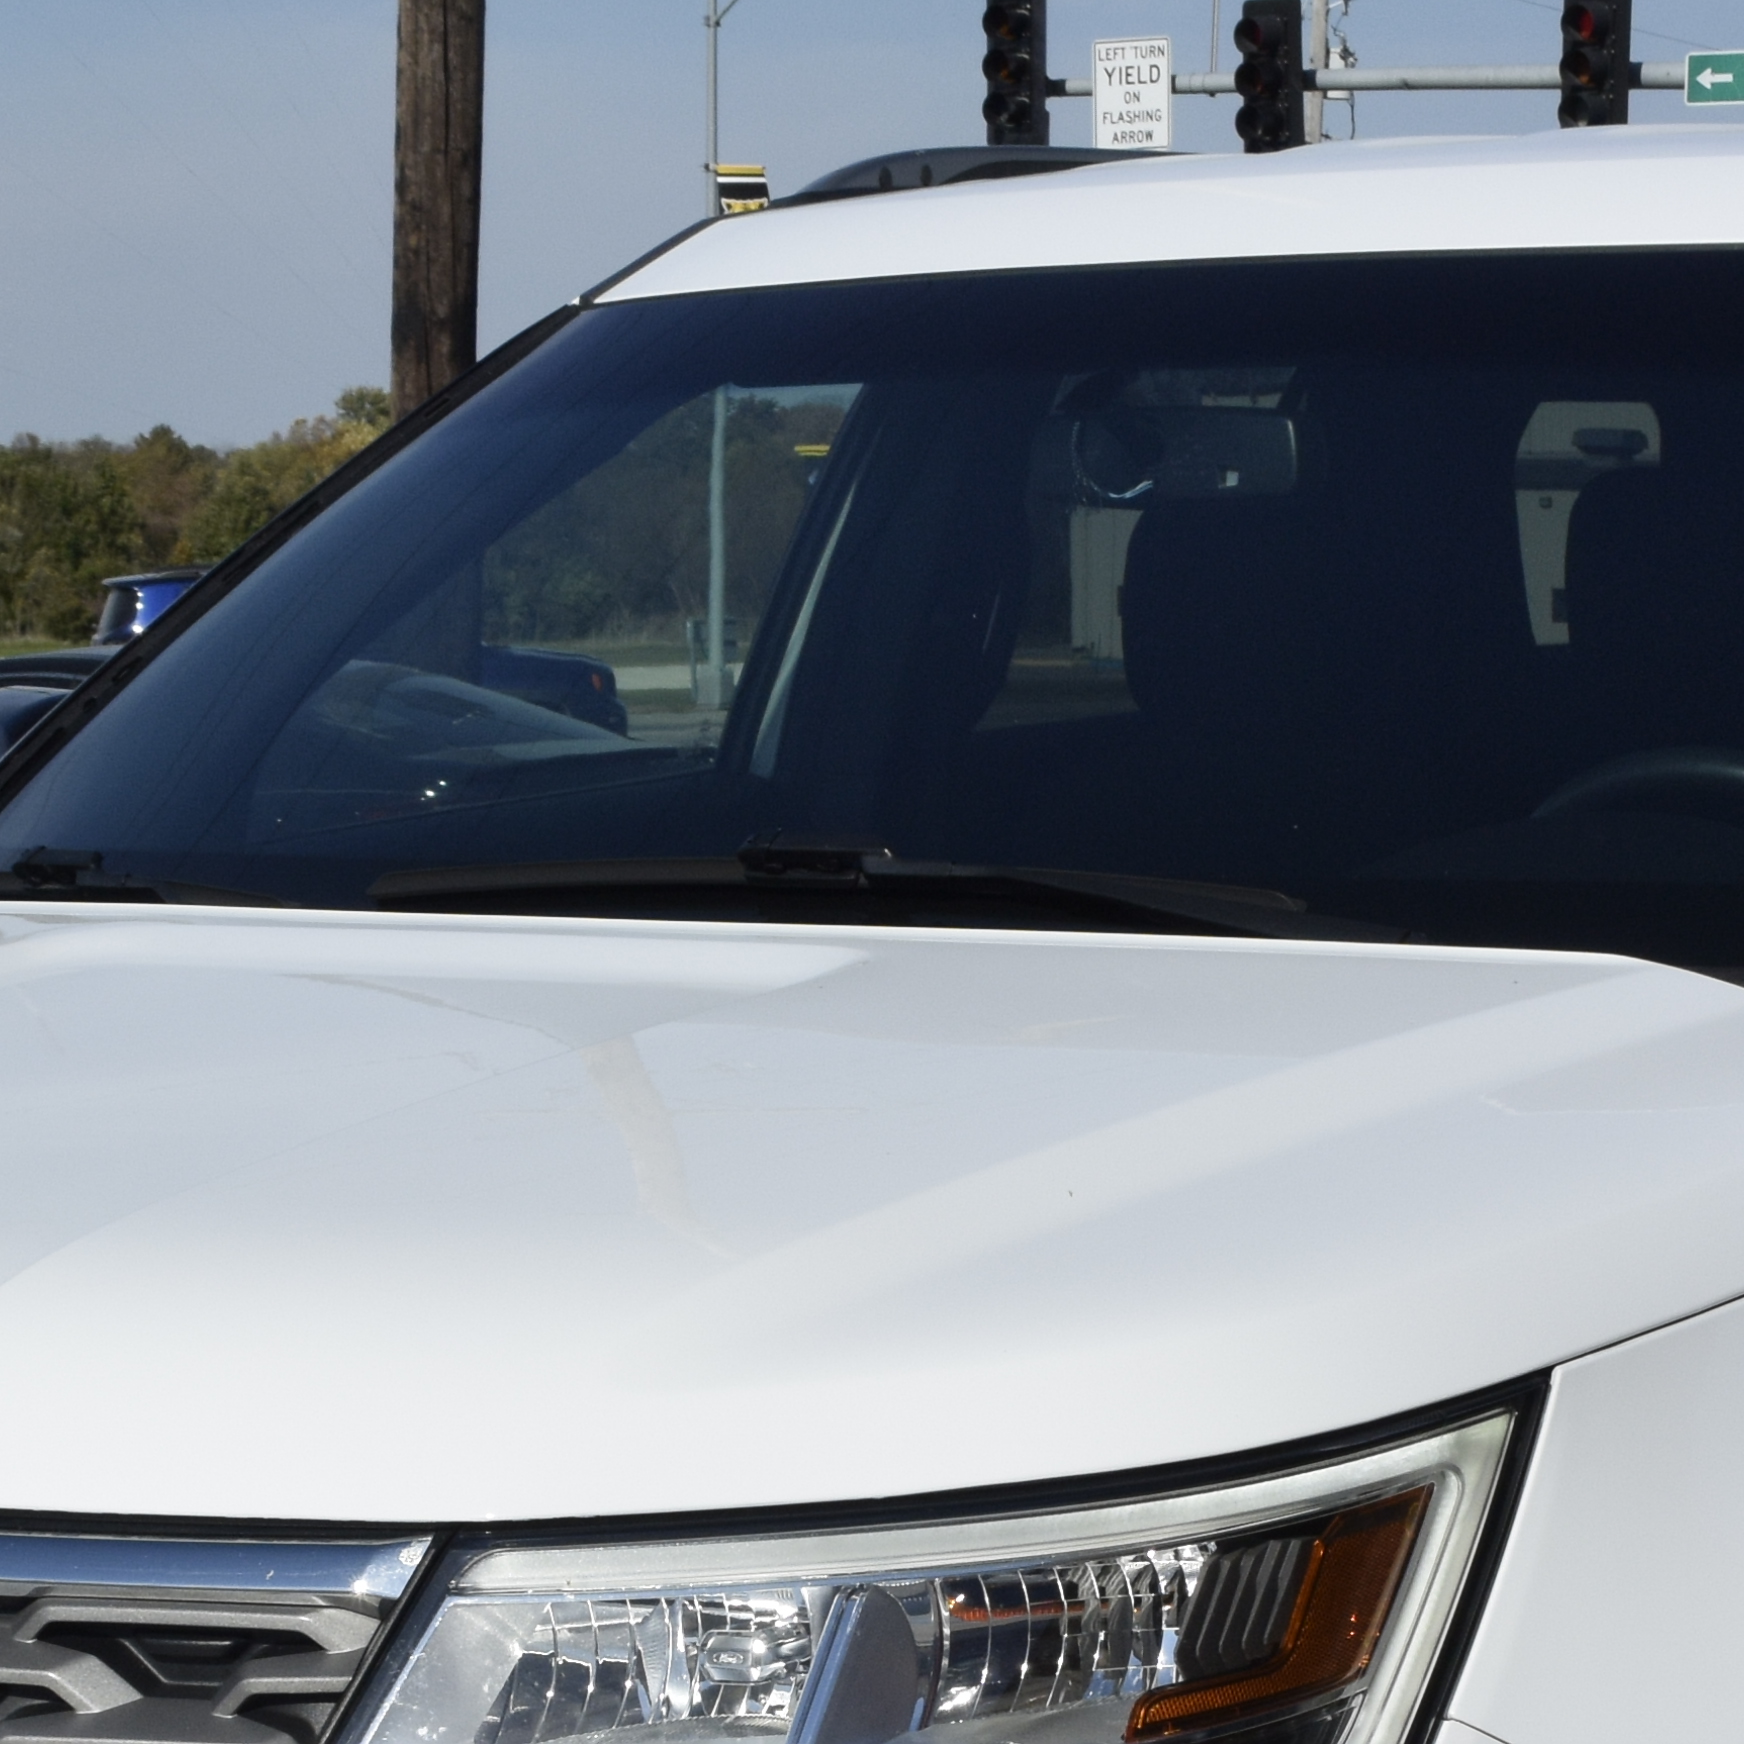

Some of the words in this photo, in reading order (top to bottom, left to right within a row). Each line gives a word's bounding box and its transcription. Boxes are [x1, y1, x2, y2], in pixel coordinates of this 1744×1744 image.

[1098, 47, 1126, 62] LEFT
[1131, 45, 1165, 59] TURN
[1103, 64, 1160, 86] YIELD
[1124, 91, 1141, 104] ON
[1103, 108, 1162, 125] FLASHING
[1112, 130, 1154, 144] ARROW
